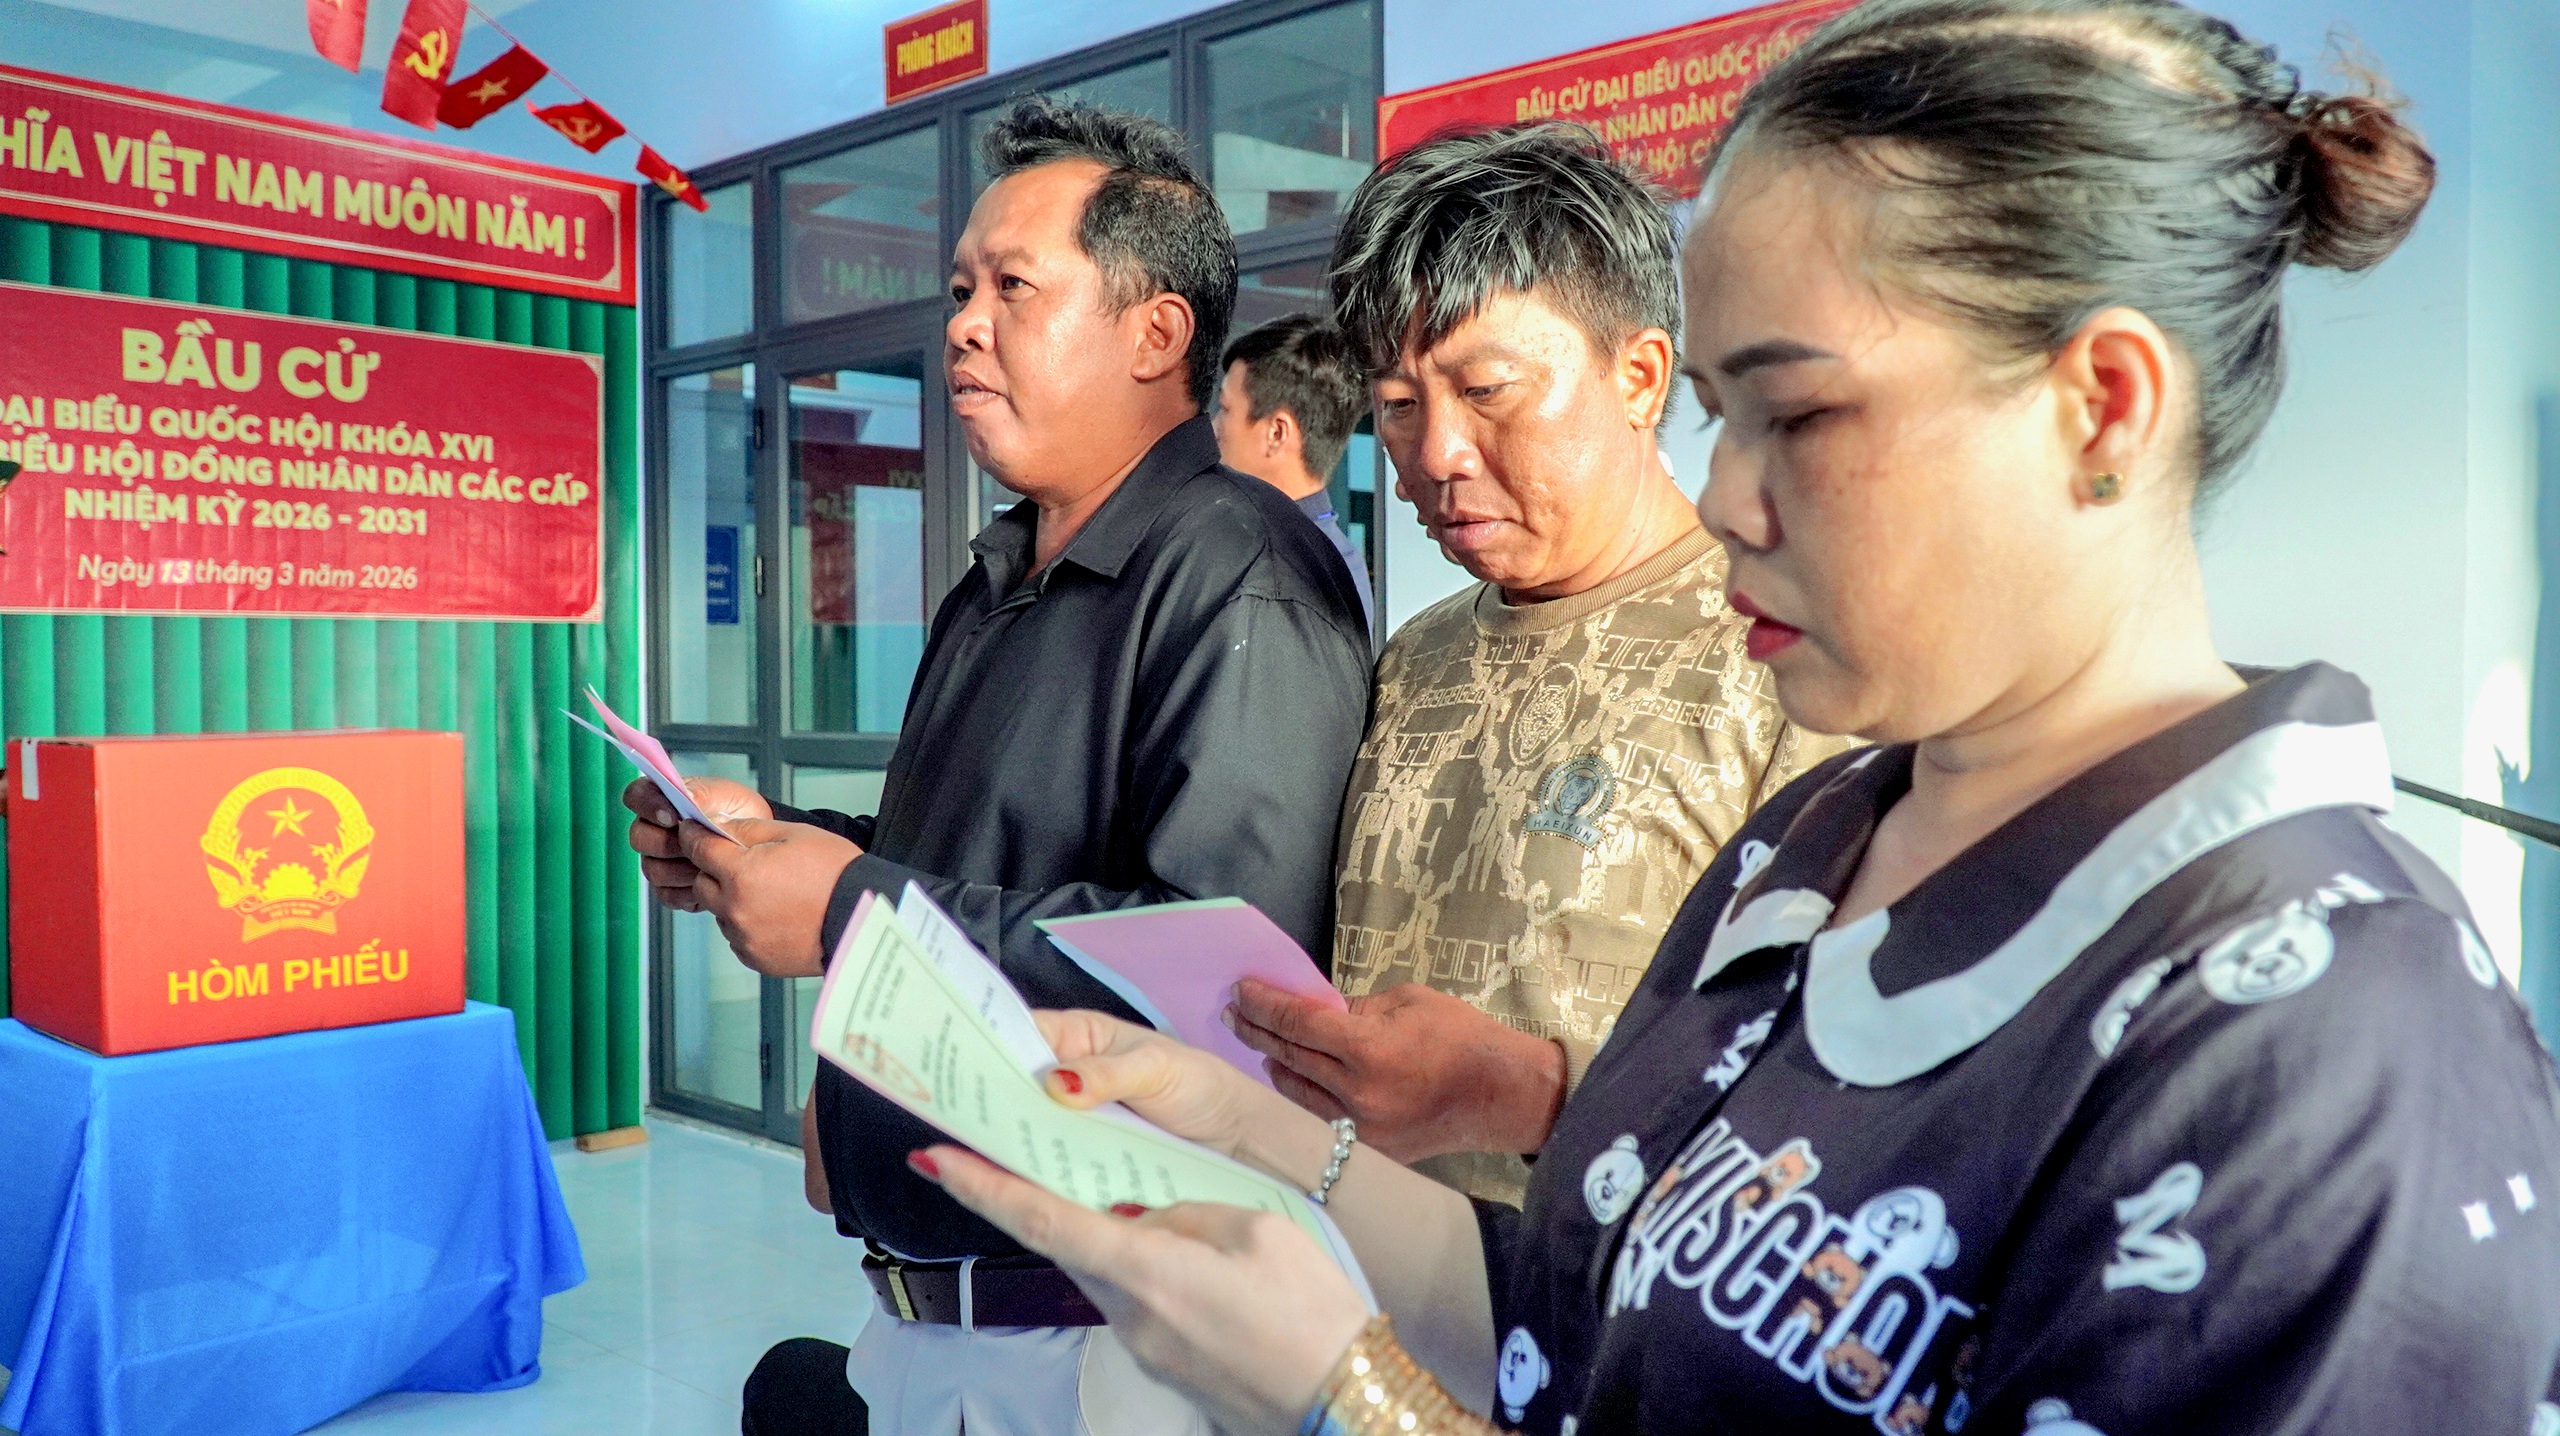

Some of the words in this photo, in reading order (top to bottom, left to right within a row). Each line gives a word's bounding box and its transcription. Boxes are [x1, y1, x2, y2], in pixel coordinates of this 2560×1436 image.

[896, 30, 935, 78] PHÒNG
[935, 17, 974, 65] KHÁCH
[1558, 76, 1592, 114] CỬ
[1593, 74, 1629, 112] ĐẠI
[1632, 56, 1681, 98] BIỂU
[1684, 41, 1752, 86] QUỐC
[1606, 103, 1667, 143] NHÂN
[1671, 91, 1717, 130] DÂN
[94, 129, 206, 207] VIỆT
[215, 153, 324, 218] NAM
[333, 177, 467, 241] MUÔN
[475, 194, 566, 258] NĂM
[574, 216, 586, 261] !
[121, 318, 262, 393] BẦU
[277, 337, 381, 403] CỬ
[0, 394, 45, 436] ẠI
[54, 393, 142, 435] BIỂU
[149, 404, 262, 443] QUỐC
[269, 412, 333, 457] HỘI
[340, 420, 434, 459] KHÓA
[439, 430, 494, 464] XVI
[83, 439, 155, 487] HỘI
[161, 444, 274, 486] ĐỒNG
[280, 455, 379, 494] NHÂN
[385, 461, 452, 499] DÂN
[458, 467, 524, 502] CÁC
[529, 471, 589, 507] CẤP
[65, 484, 189, 531] NHIỆM
[196, 489, 247, 527] KỲ
[252, 499, 333, 531] 2026
[358, 505, 428, 537] 2031
[78, 554, 154, 587] Ngày
[160, 559, 193, 584] 13
[195, 557, 274, 592] tháng
[277, 561, 295, 586] 3
[299, 563, 355, 588] năm
[358, 565, 419, 590] 2026
[1533, 820, 1593, 841] HAEIXUN
[167, 958, 269, 1005] HÒM
[283, 937, 410, 993] PHIẾU
